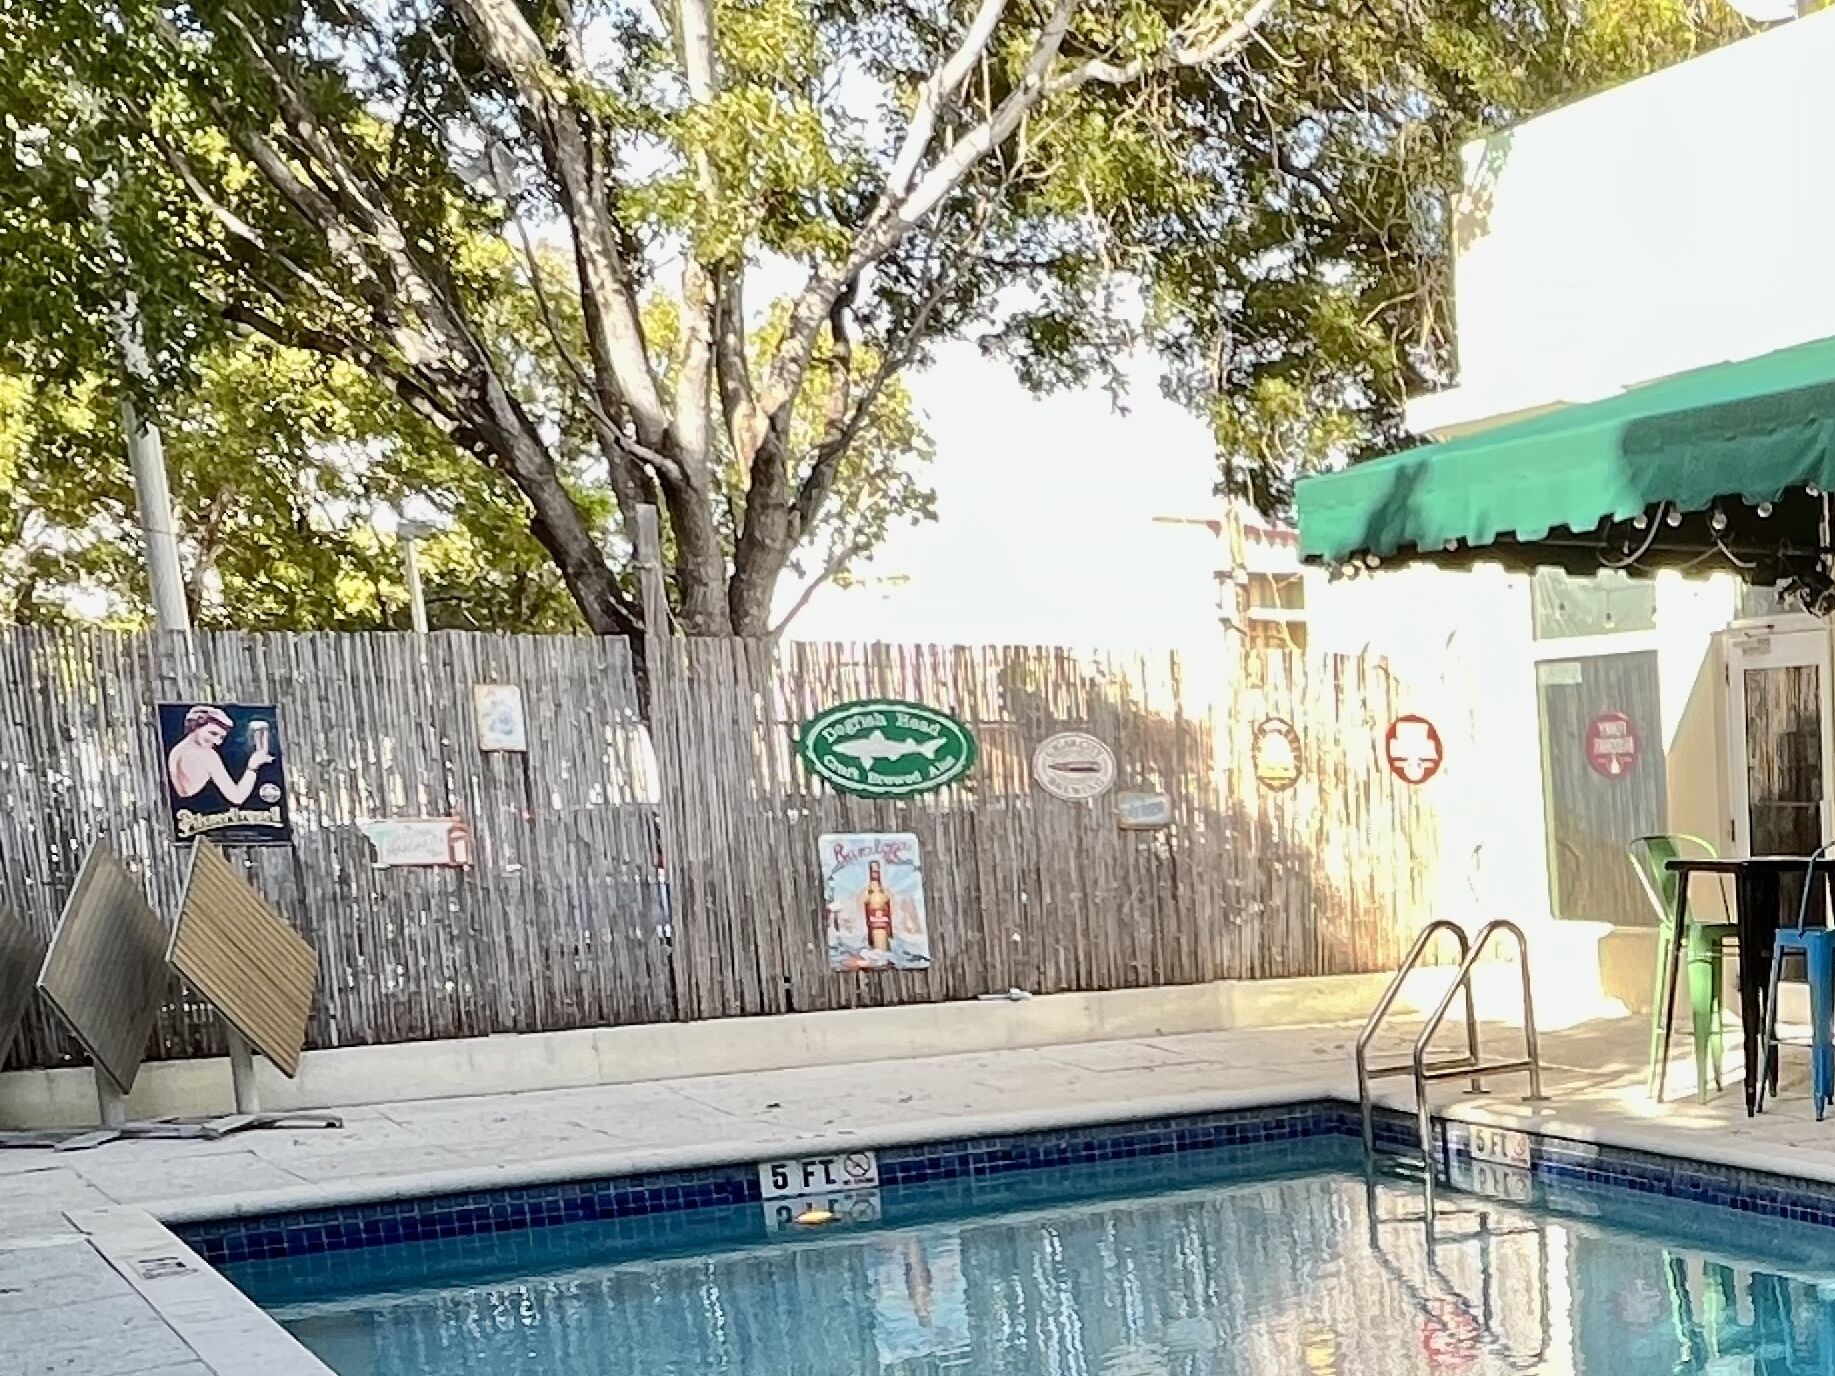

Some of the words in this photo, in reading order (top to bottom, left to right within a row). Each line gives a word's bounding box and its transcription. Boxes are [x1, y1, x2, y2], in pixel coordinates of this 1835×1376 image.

[821, 711, 887, 743] Dogfish
[895, 711, 942, 738] Head
[771, 1163, 789, 1190] 5
